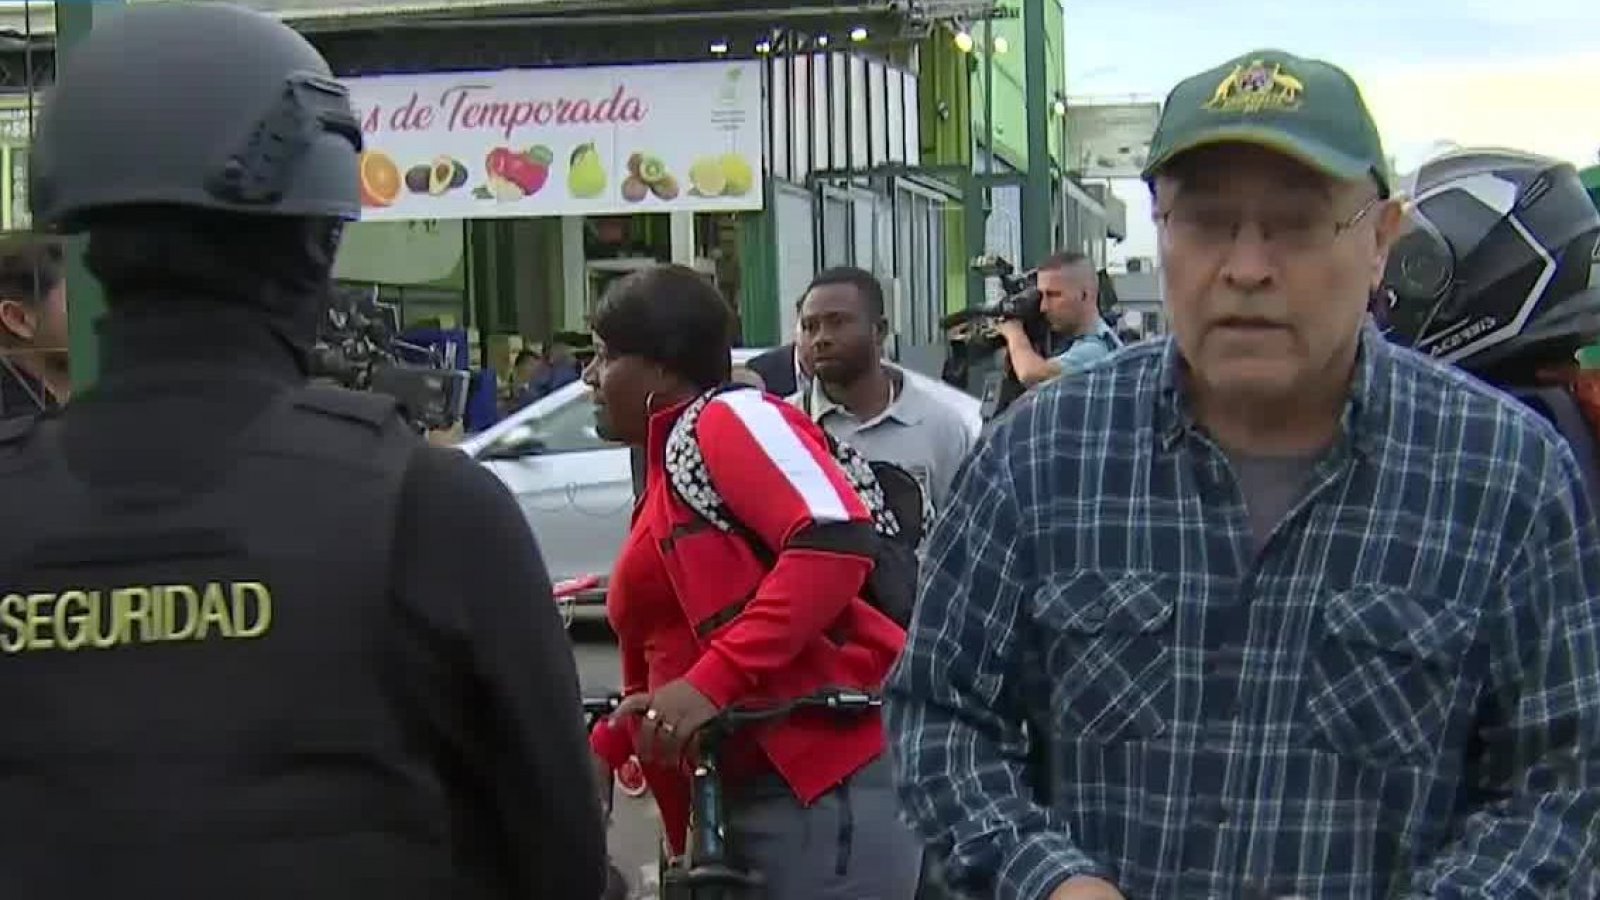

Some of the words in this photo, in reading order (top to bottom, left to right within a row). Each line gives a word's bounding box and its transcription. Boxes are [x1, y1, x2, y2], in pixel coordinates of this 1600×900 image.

[389, 91, 432, 131] de
[440, 84, 648, 138] Temporada
[0, 581, 272, 654] SEGURIDAD
